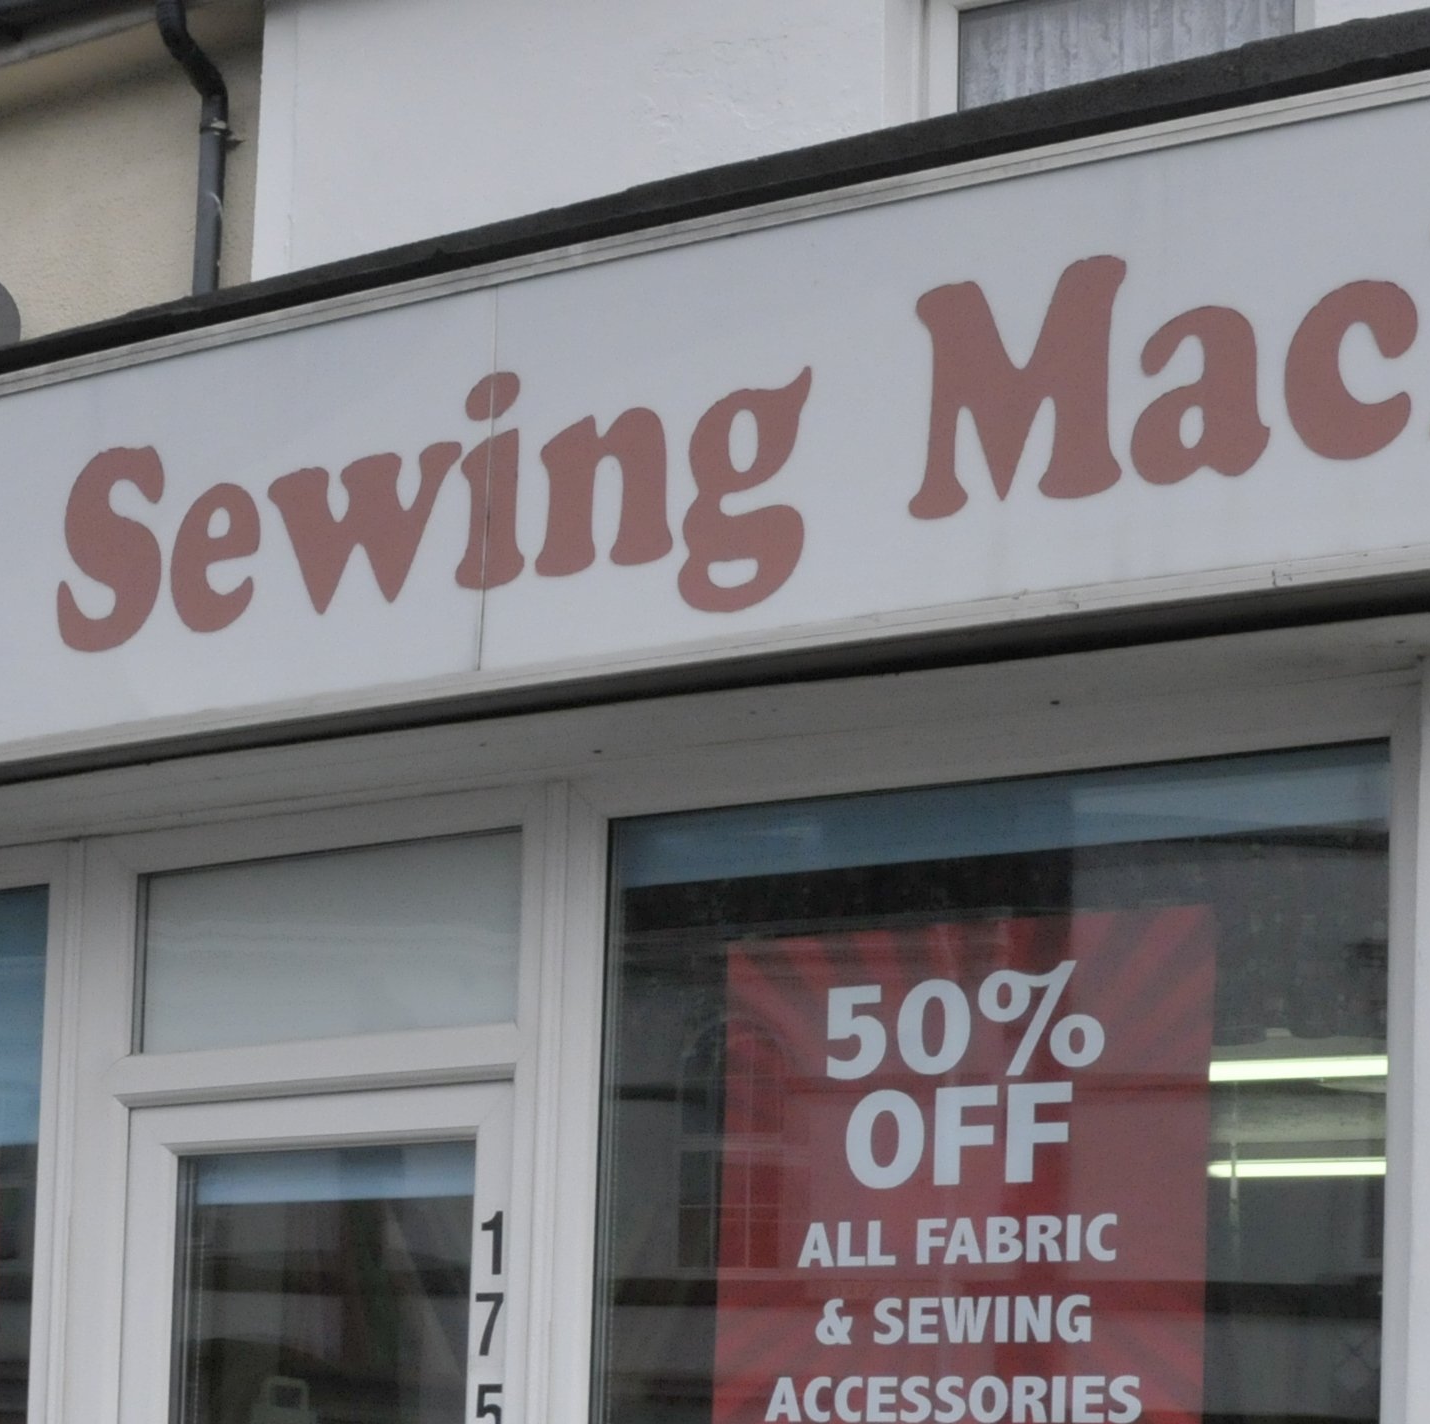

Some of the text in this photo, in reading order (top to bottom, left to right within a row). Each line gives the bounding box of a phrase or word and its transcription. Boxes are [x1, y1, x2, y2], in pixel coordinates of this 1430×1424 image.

[57, 365, 812, 652] Sewing
[826, 960, 1105, 1080] 50%
[846, 1081, 1072, 1189] OFF
[797, 1213, 1118, 1268] ALL FABRIC
[815, 1294, 1092, 1346] & SEWING
[764, 1374, 1143, 1424] ACCESSORIES
